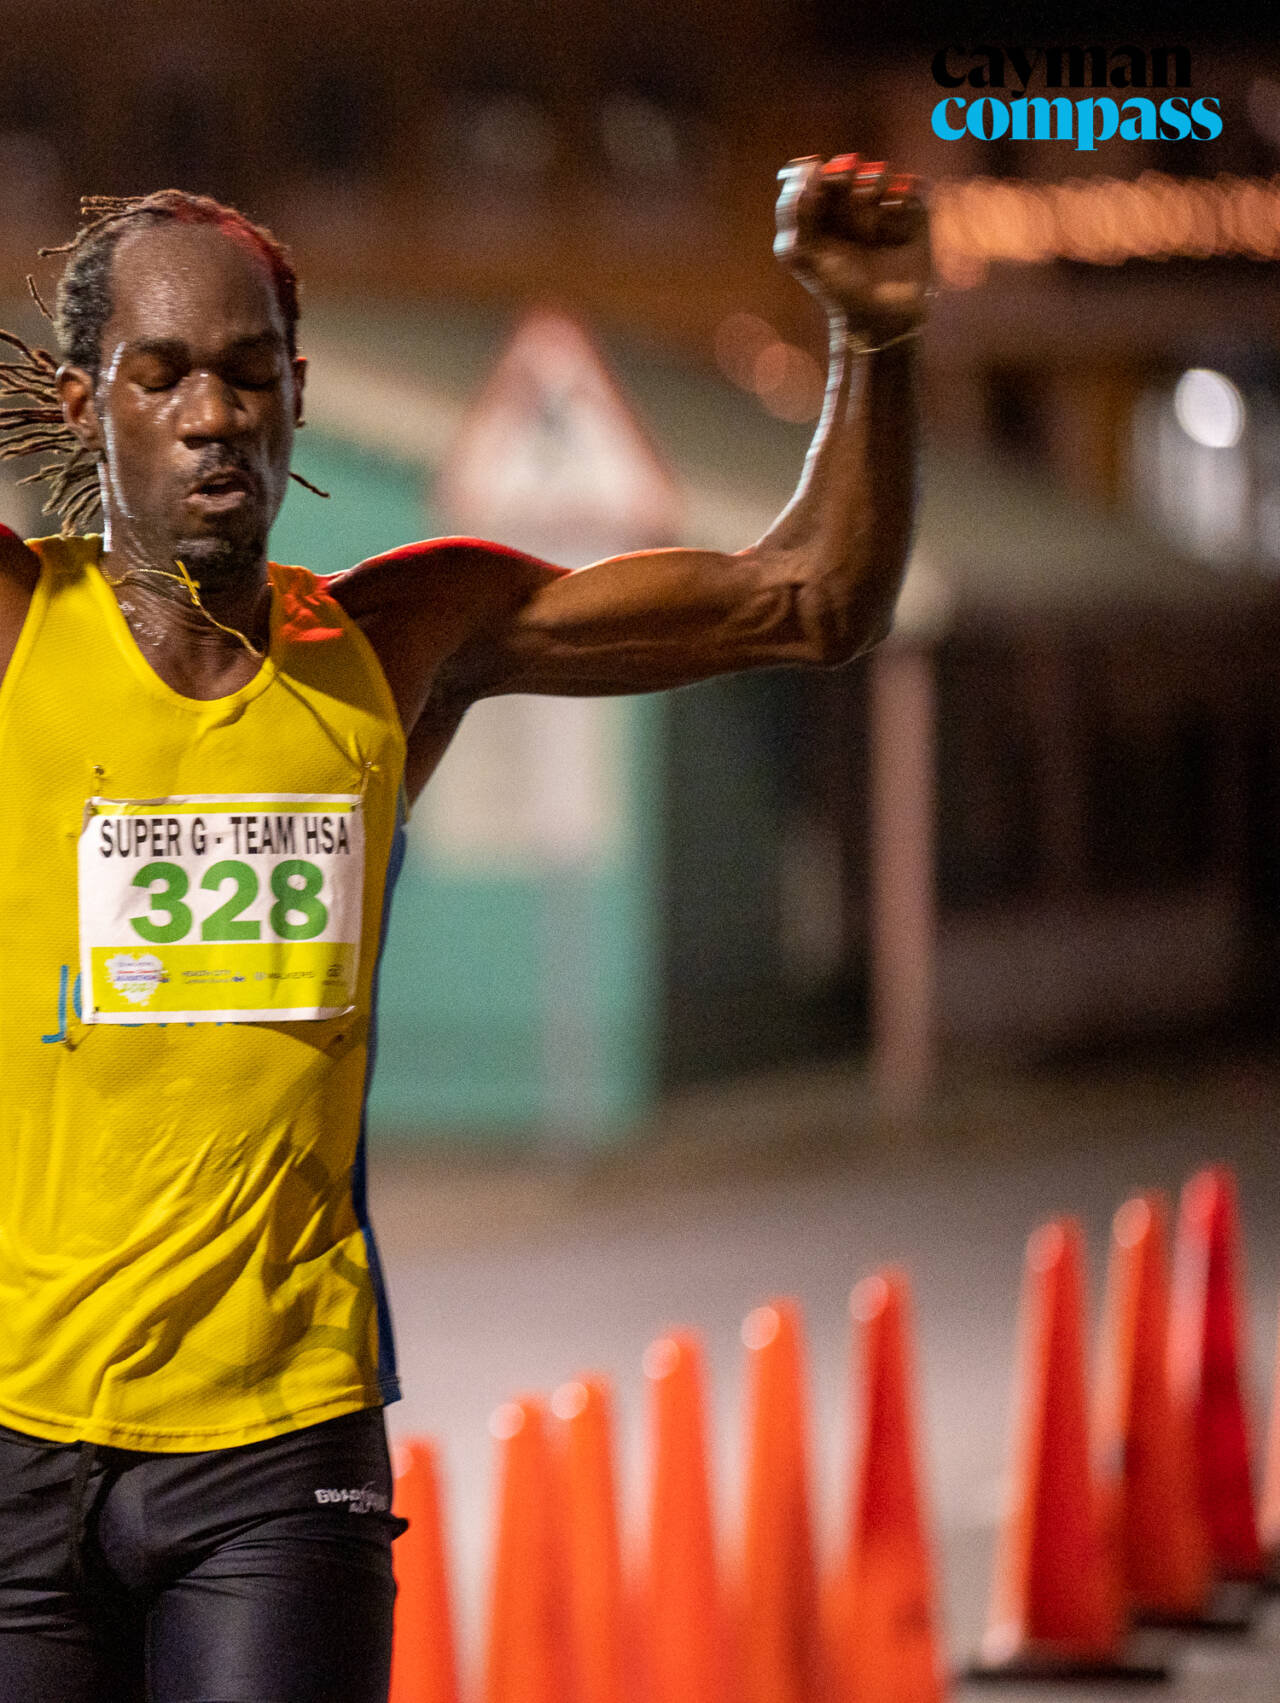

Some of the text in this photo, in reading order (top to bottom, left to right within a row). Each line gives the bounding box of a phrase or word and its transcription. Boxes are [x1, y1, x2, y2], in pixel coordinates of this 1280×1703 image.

[100, 818, 182, 858] SUPER
[191, 817, 206, 856] G
[230, 816, 296, 855] TEAM
[303, 816, 350, 855] HSA
[129, 859, 329, 943] 328
